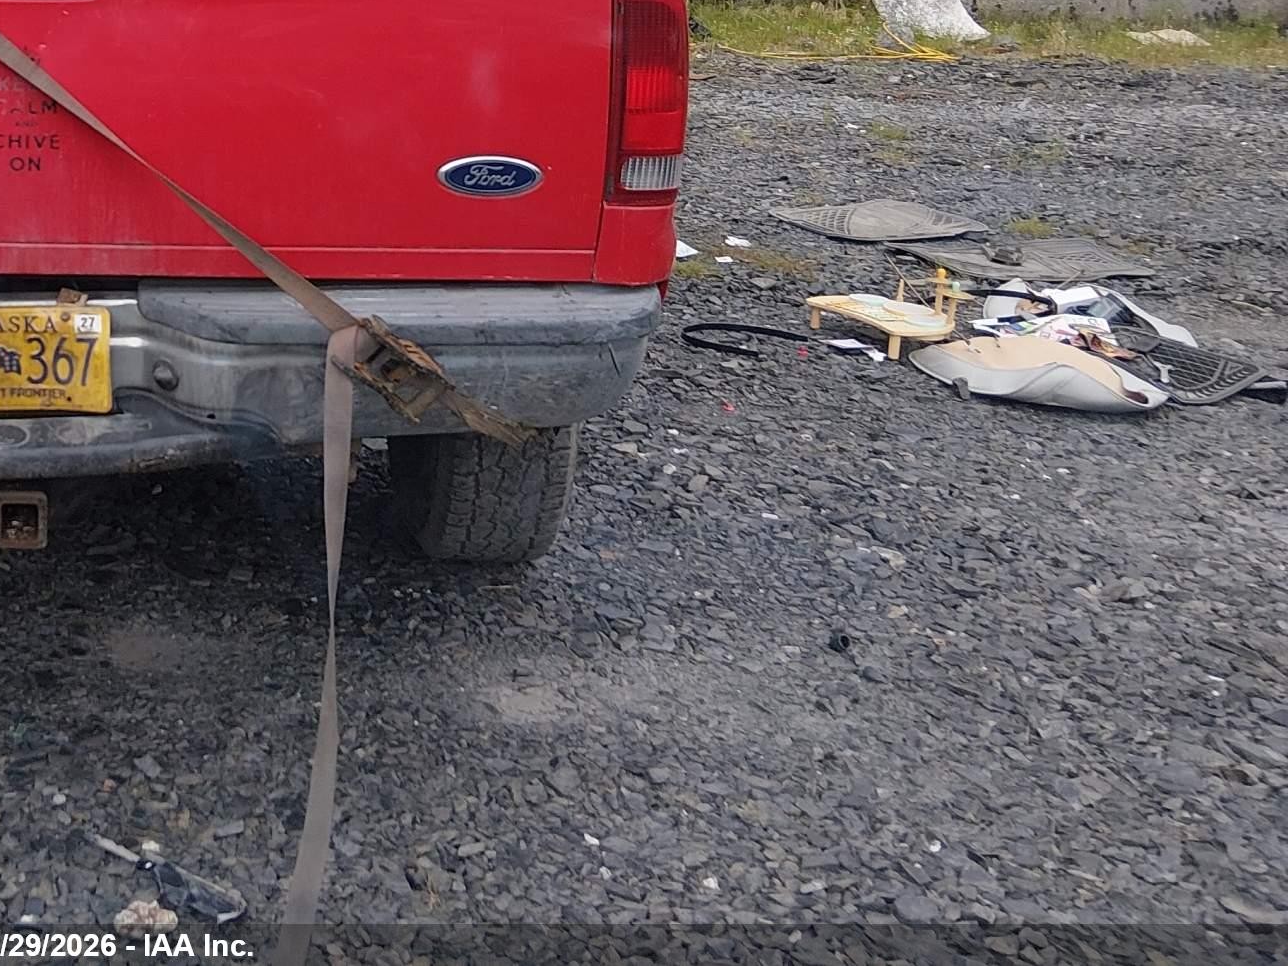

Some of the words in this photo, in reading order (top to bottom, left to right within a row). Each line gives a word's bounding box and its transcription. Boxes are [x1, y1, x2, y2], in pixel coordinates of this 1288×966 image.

[9, 157, 41, 171] ON
[464, 164, 516, 186] Ford
[81, 317, 96, 329] 27
[26, 336, 98, 387] 367
[9, 387, 67, 400] FRONTIER
